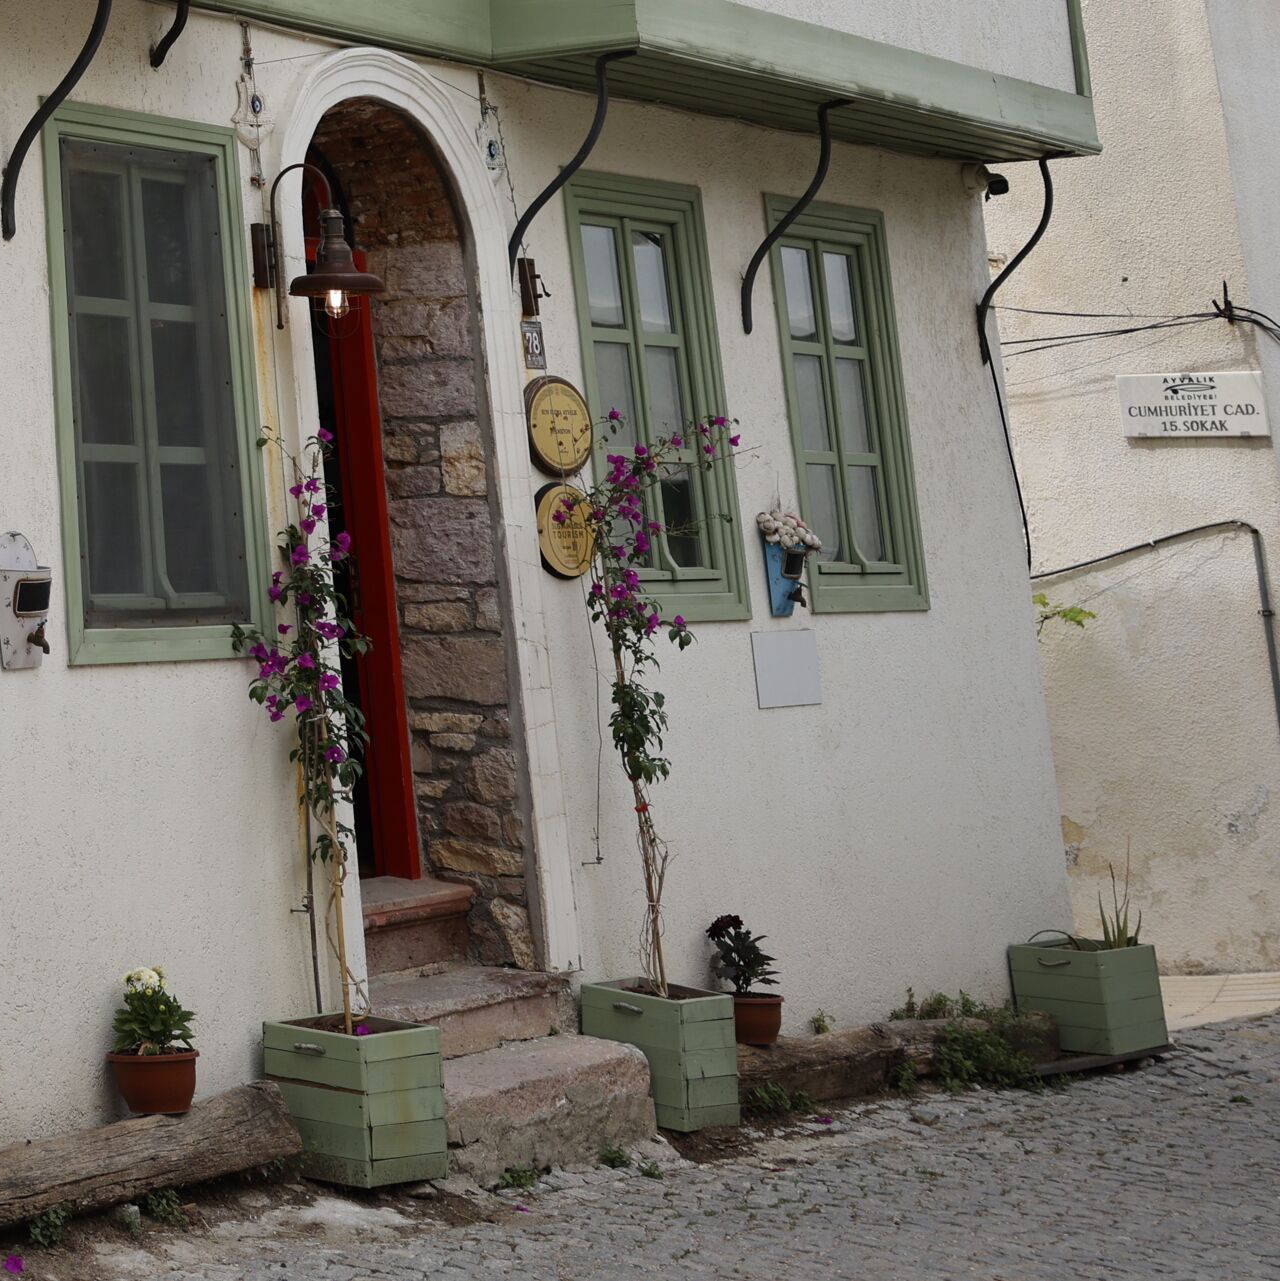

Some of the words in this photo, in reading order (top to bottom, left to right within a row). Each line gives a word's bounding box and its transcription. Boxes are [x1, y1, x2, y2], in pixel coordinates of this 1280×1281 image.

[526, 332, 540, 354] 78
[1162, 376, 1216, 384] AYVALIK
[1128, 402, 1218, 418] CUMHURİYET
[1223, 403, 1260, 416] CAD.
[552, 530, 584, 539] TOURISM
